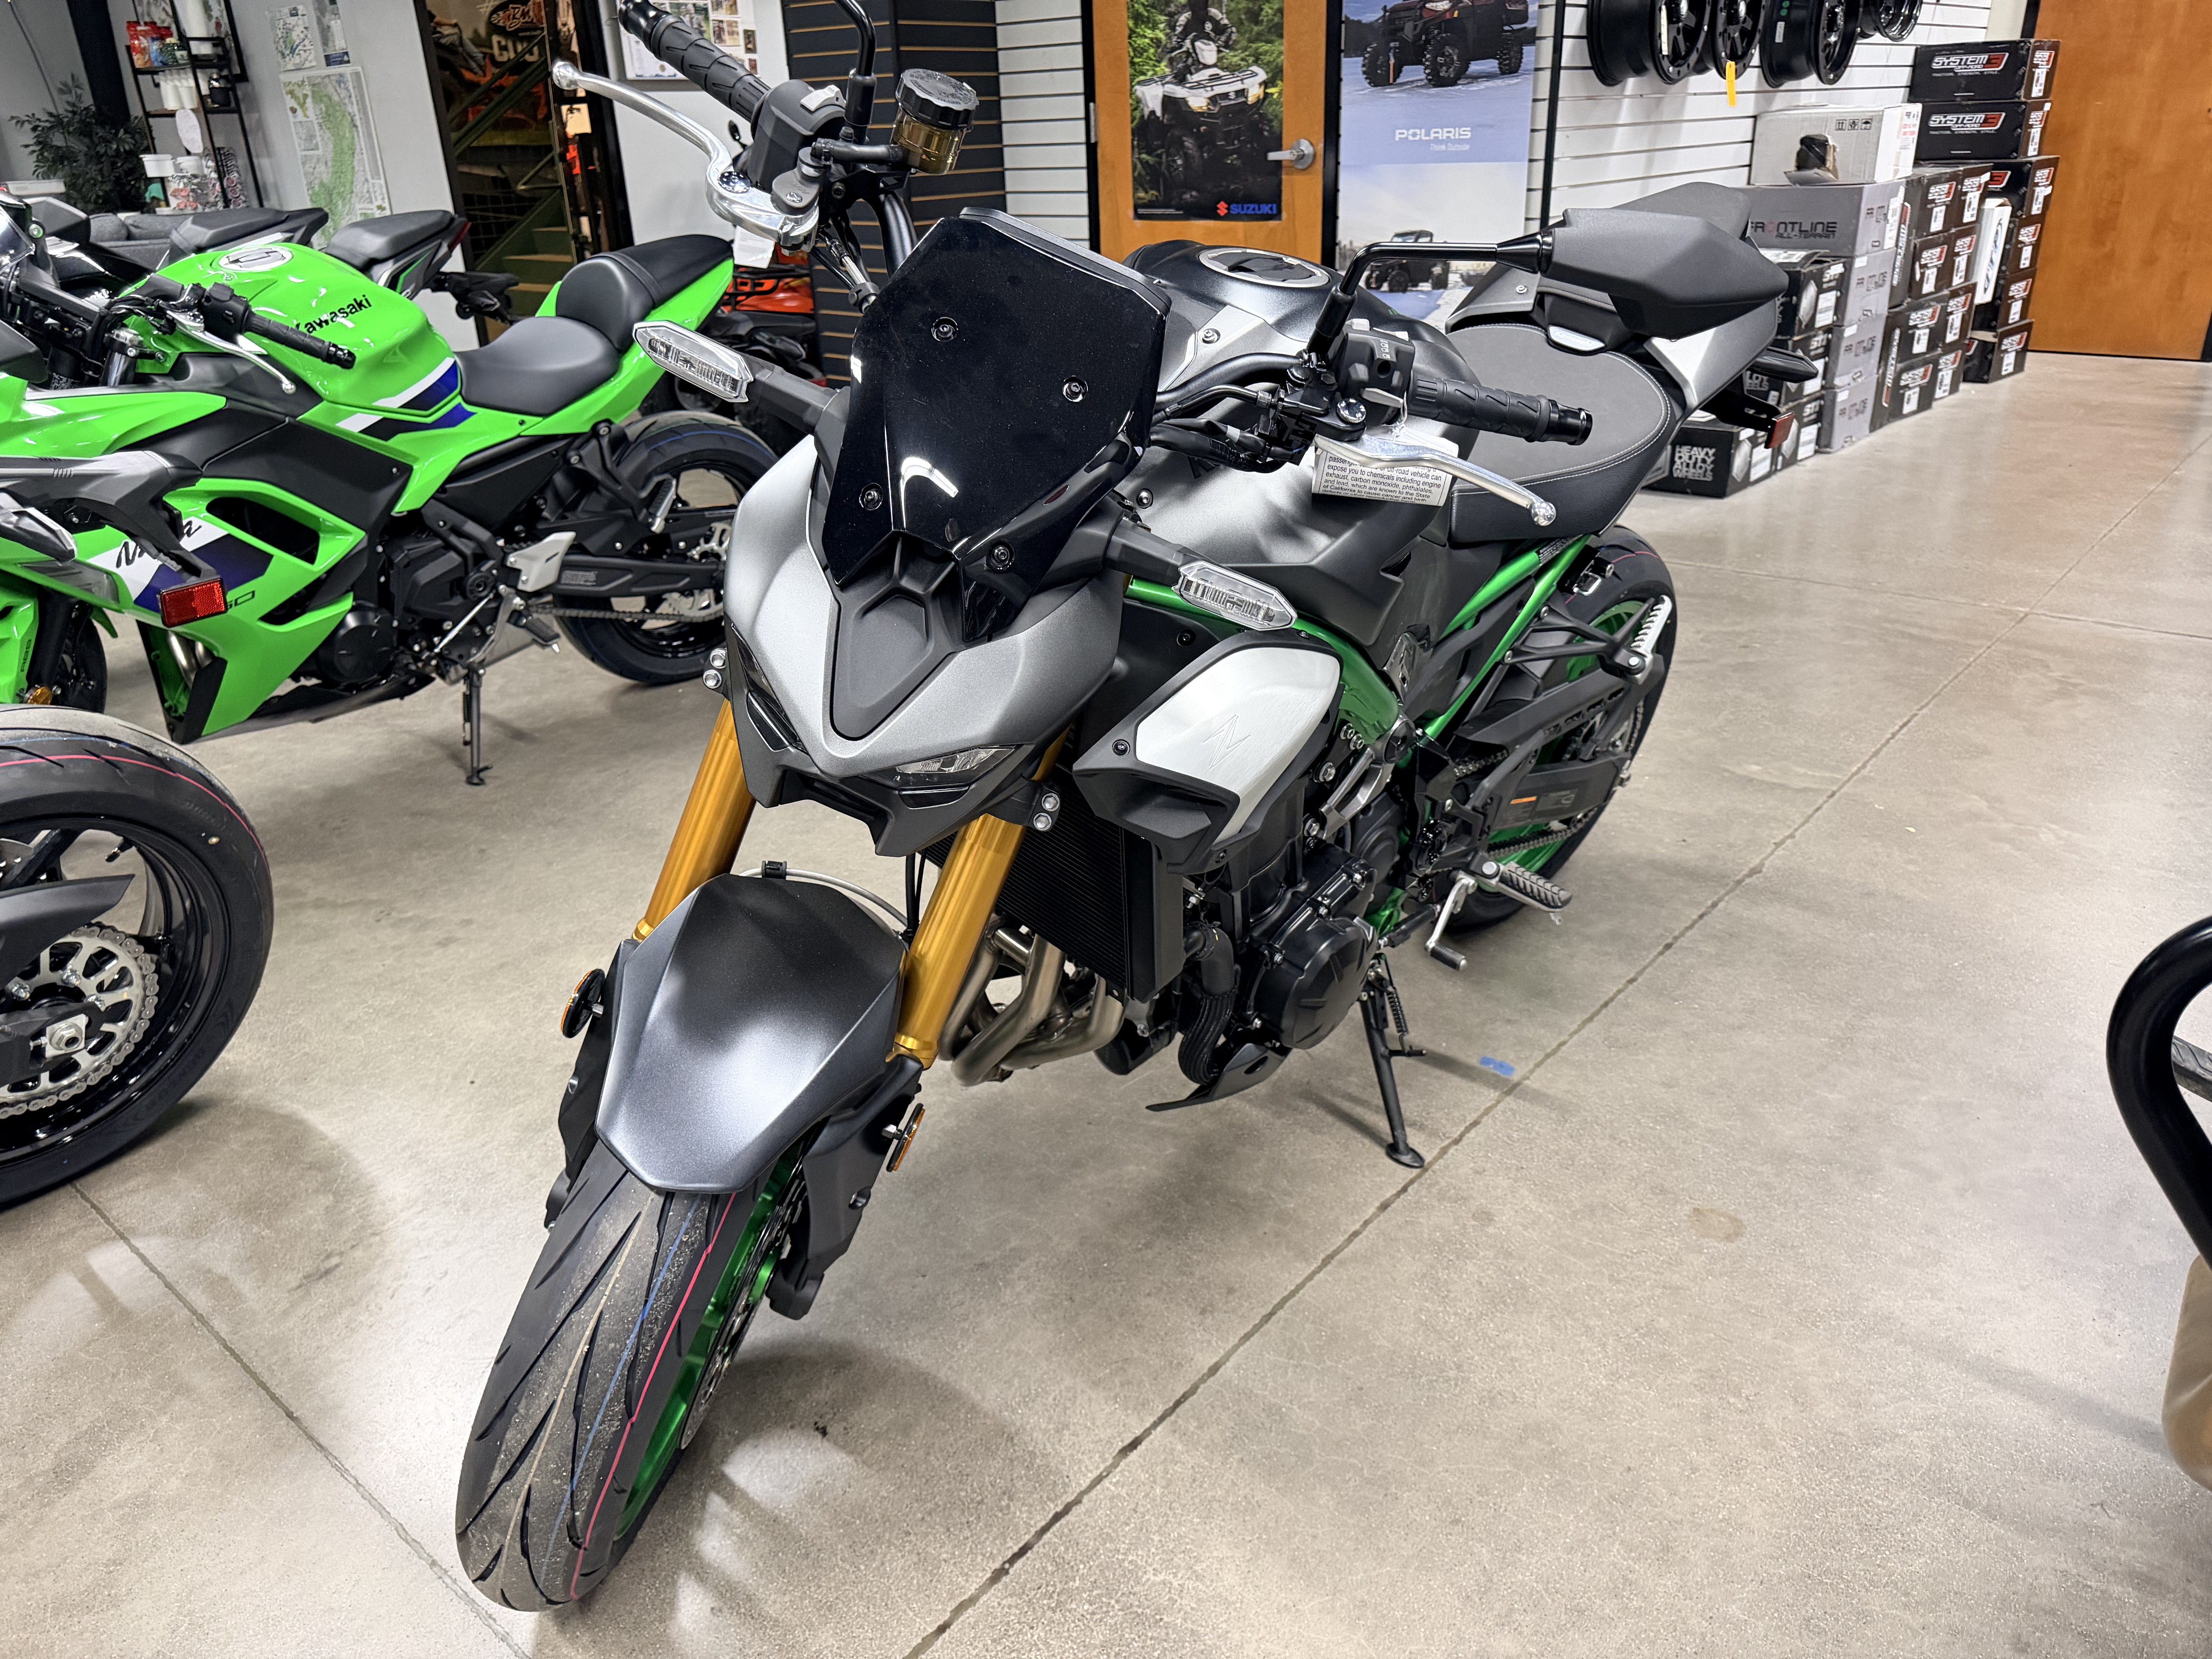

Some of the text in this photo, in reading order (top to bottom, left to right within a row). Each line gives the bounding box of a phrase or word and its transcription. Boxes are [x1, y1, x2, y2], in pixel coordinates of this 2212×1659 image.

[1395, 127, 1471, 141] POLARIS
[1230, 204, 1277, 214] SUZUKI
[1675, 445, 1717, 458] HEAVY
[1328, 464, 1347, 474] expose
[1367, 470, 1395, 481] chemicals
[1396, 475, 1421, 486] including
[1411, 470, 1430, 479] vehicle
[1326, 472, 1433, 494] exhaust, carbon monoxide, phthalates,
